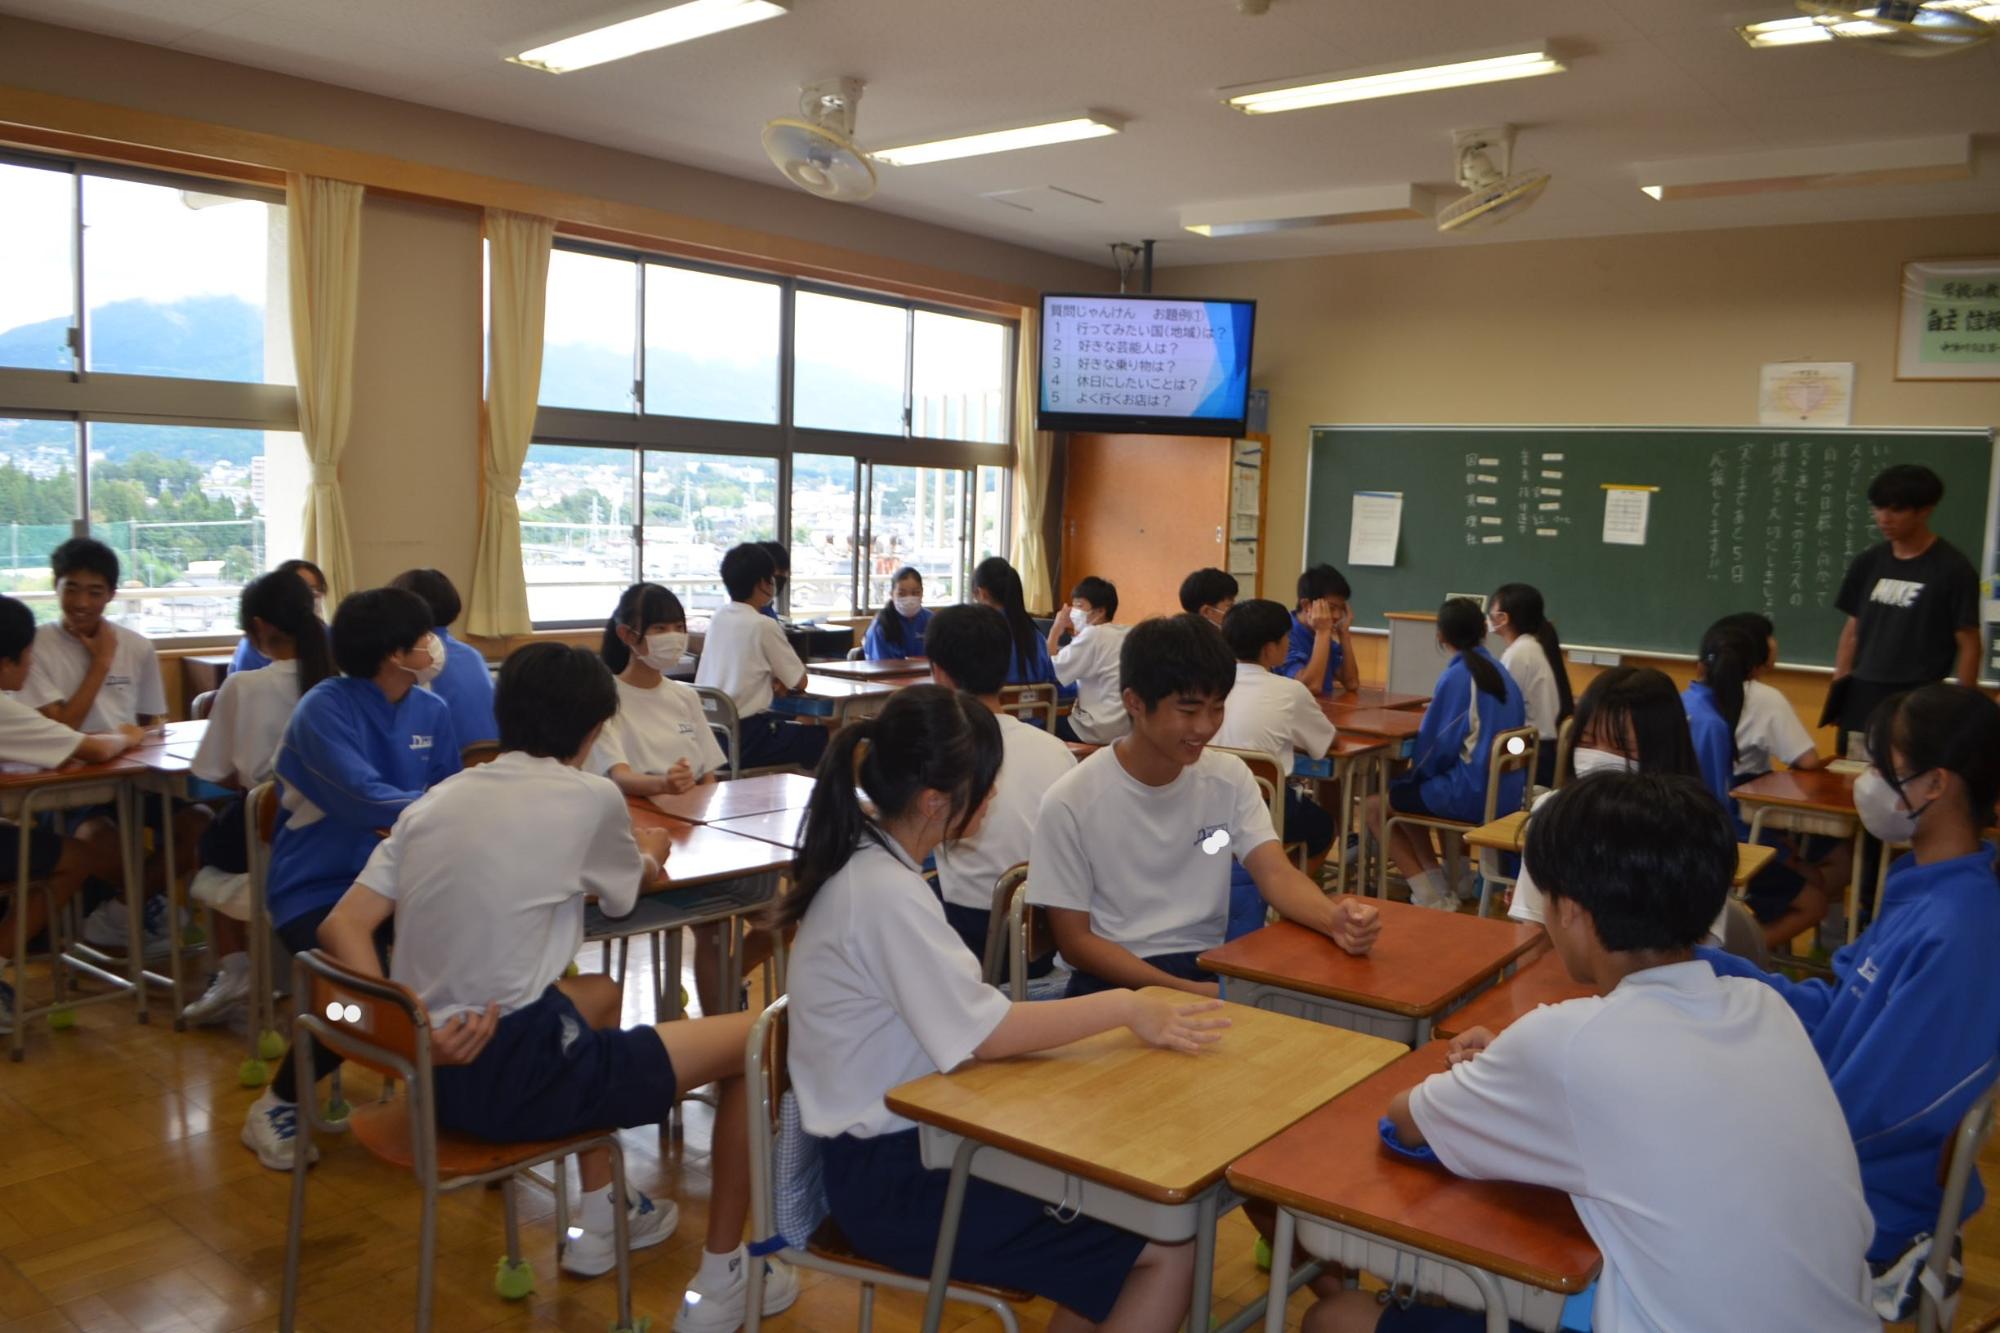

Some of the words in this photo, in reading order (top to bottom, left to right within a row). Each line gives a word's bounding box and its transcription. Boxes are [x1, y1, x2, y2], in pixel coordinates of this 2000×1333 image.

[1051, 304, 1136, 320] 質問じゃんけん
[1053, 339, 1062, 351] 2
[1078, 340, 1179, 355] 好きな芸能人は？
[1052, 357, 1061, 369] 3
[1077, 358, 1176, 373] 好きな乗り物は？
[1051, 375, 1060, 386] 4
[1076, 376, 1198, 391] 休日にしたいことは？
[1051, 391, 1060, 402] 5
[1076, 393, 1172, 407] よく行くお店は？
[1869, 578, 1926, 607] NIKE
